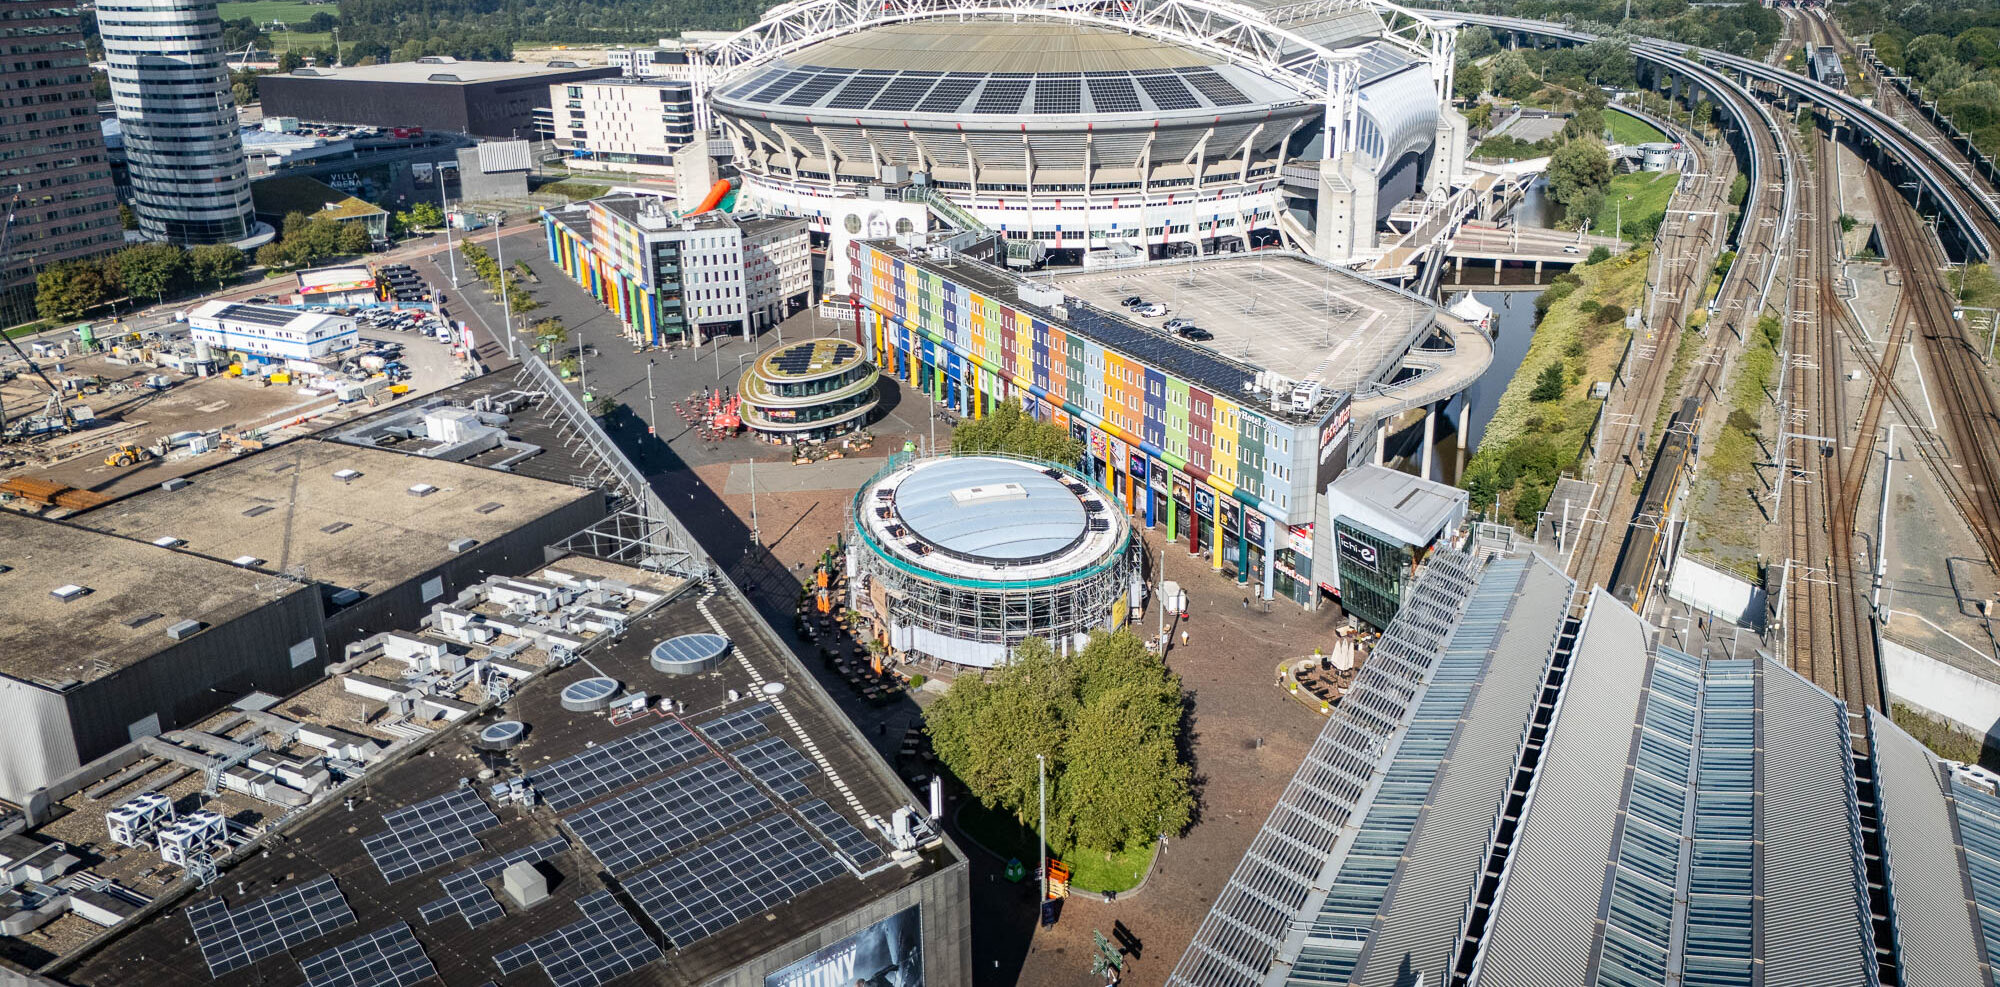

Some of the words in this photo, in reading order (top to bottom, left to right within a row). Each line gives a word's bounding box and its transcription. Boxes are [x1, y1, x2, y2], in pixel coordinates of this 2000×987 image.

[330, 172, 359, 180] VILLA
[330, 180, 362, 188] ARENA
[1227, 407, 1278, 433] easyHotel.com
[1340, 538, 1375, 562] ichi-e
[778, 949, 857, 987] TINY
